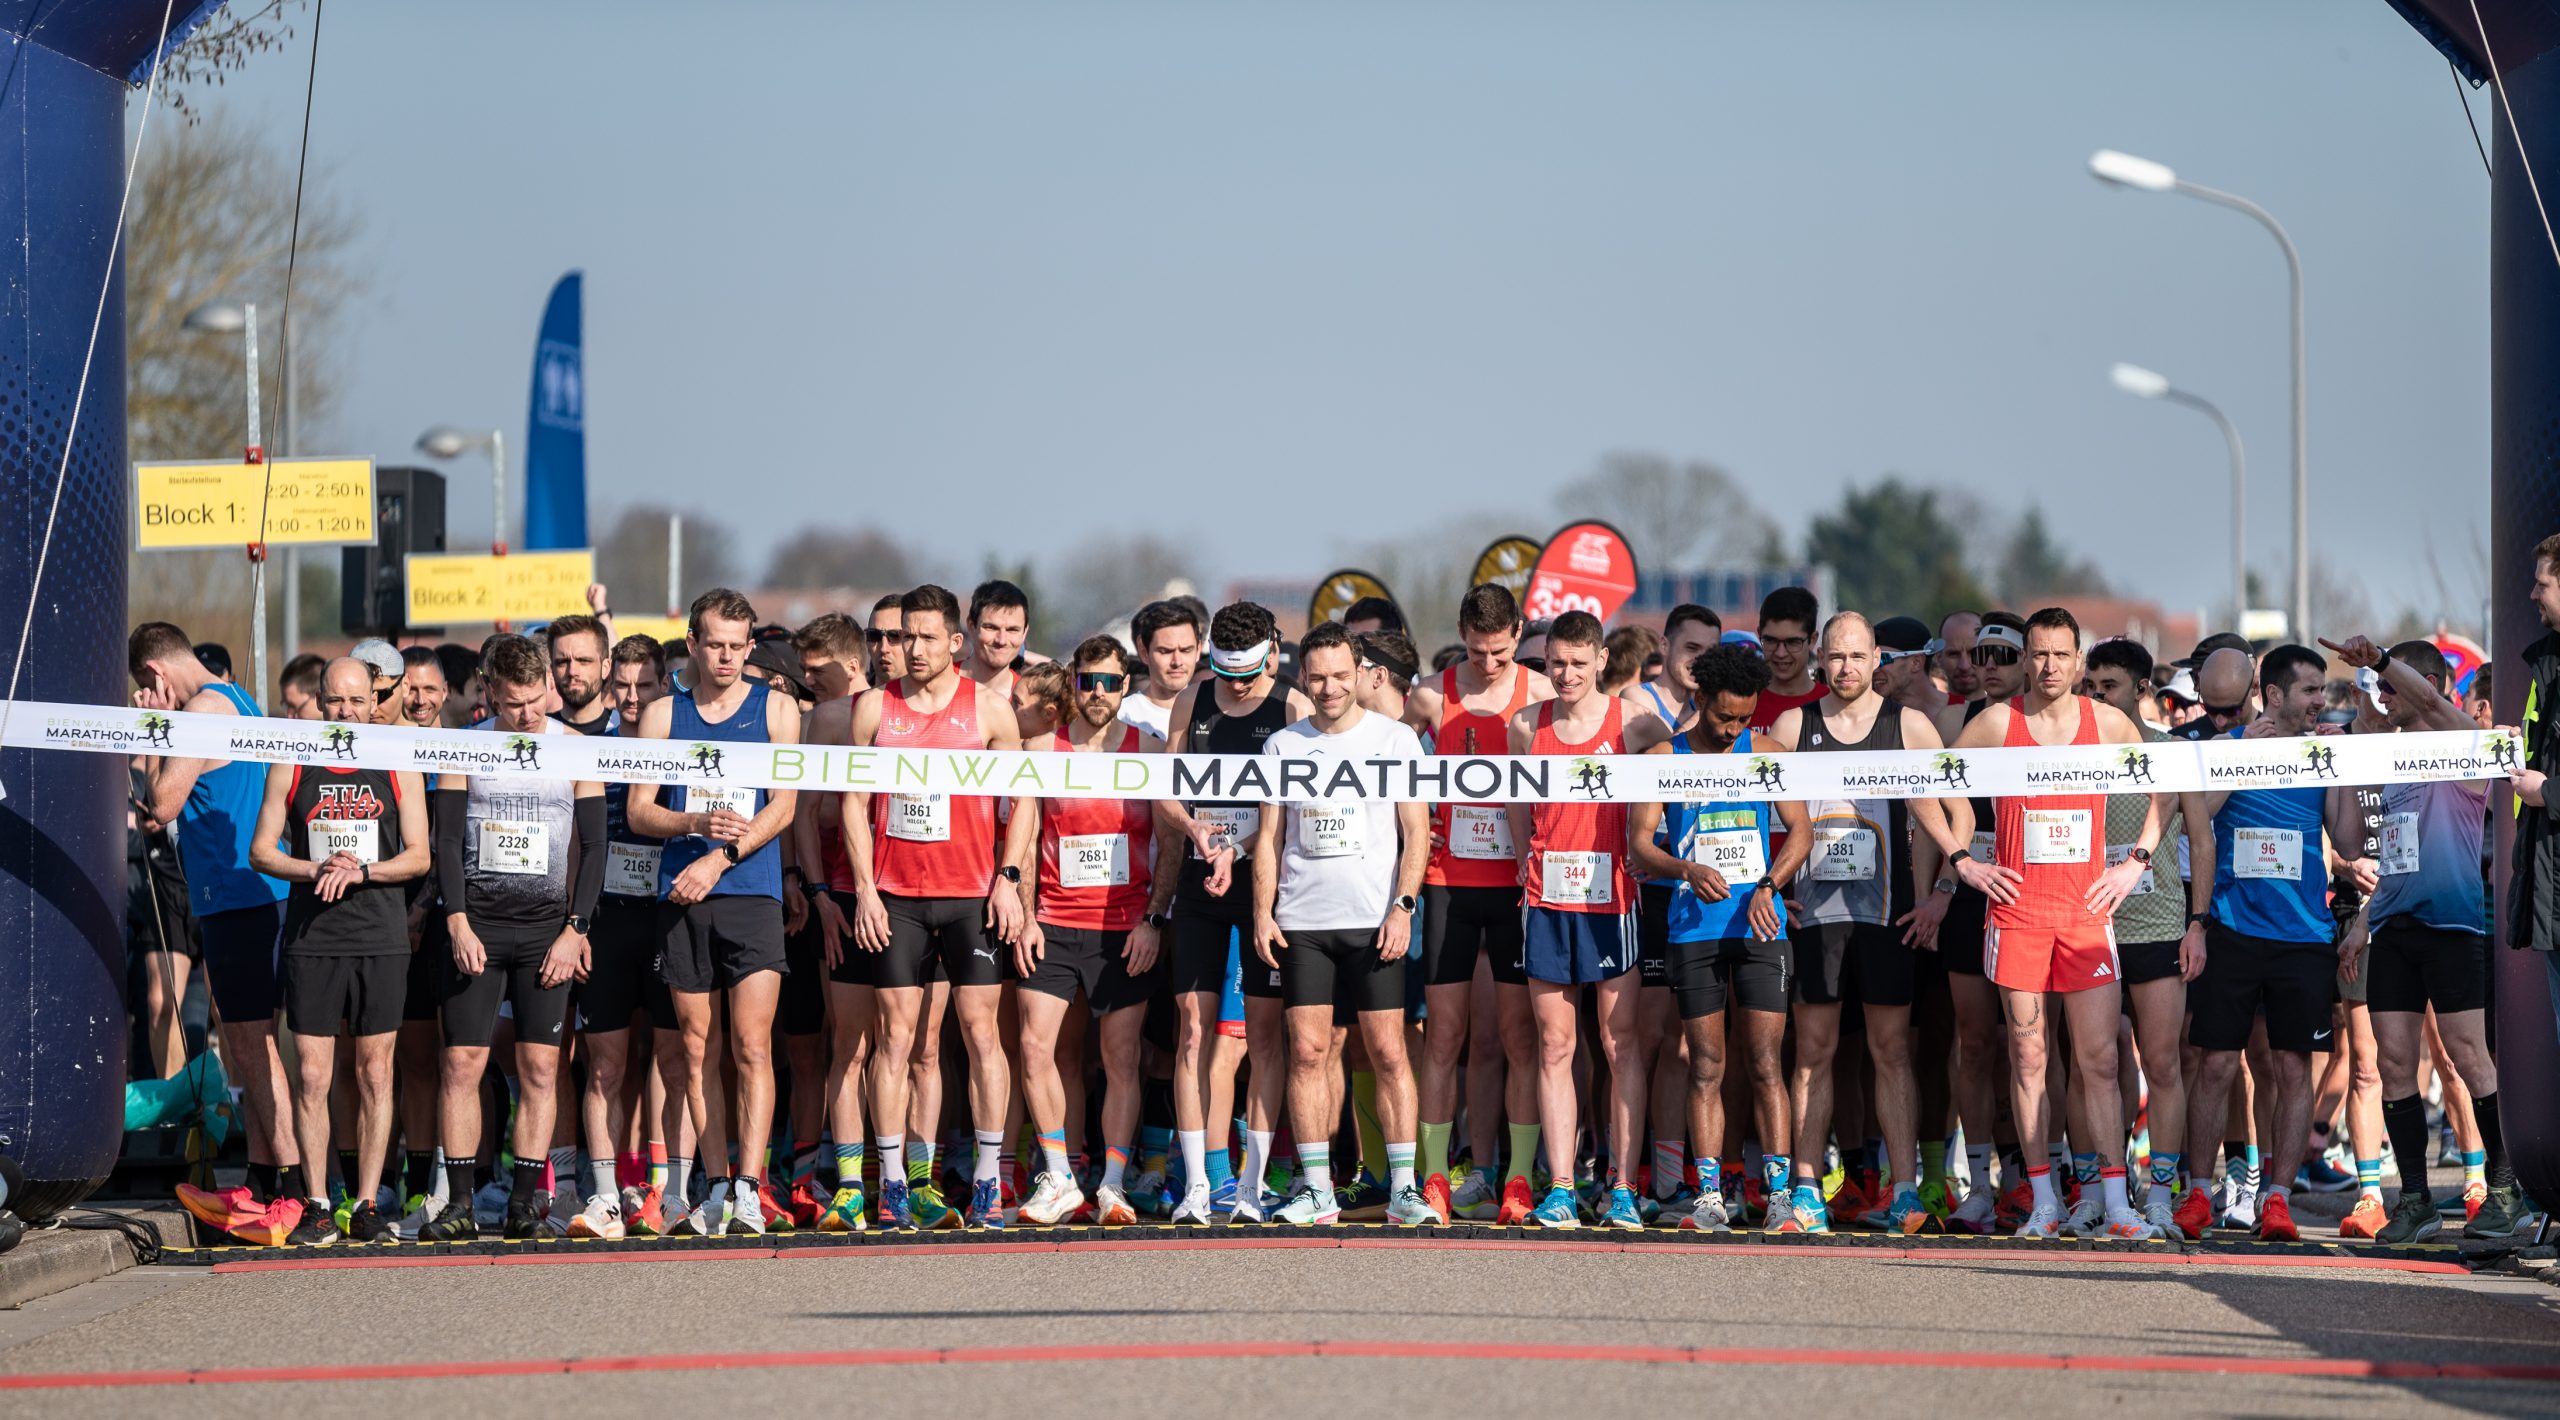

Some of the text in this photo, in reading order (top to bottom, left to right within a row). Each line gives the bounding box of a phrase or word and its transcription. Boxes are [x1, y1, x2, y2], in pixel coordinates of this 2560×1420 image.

[267, 484, 299, 499] 2:20
[315, 483, 350, 498] 2:50
[355, 482, 364, 497] h
[146, 502, 246, 526] Block 1:
[267, 518, 299, 533] 1:00
[318, 517, 351, 532] 1:20
[356, 517, 365, 531] h
[413, 586, 491, 607] Block 2:
[47, 718, 125, 729] BIENWALD
[46, 727, 134, 742] MARATHON
[230, 738, 318, 753] MARATHON
[414, 749, 501, 763] MARATHON
[597, 758, 685, 771] MARATHON
[1843, 765, 1920, 775] BIENWALD
[2210, 764, 2298, 778] MARATHON
[2394, 758, 2482, 771] MARATHON
[771, 748, 1550, 799] BIENWALD MARATHON
[1658, 768, 1736, 777] BIENWALD
[2027, 770, 2115, 782] MARATHON
[1658, 778, 1746, 789] MARATHON
[1843, 774, 1931, 786] MARATHON
[705, 800, 733, 813] 1896
[903, 803, 931, 817] 1861
[1315, 818, 1345, 832] 2720
[1472, 822, 1495, 835] 474
[2048, 825, 2071, 839] 193
[2386, 827, 2399, 842] 147
[328, 835, 358, 847] 1009
[498, 836, 529, 849] 2328
[1715, 846, 1746, 861] 2082
[1826, 843, 1855, 856] 1381
[2261, 842, 2276, 855] 96
[1079, 850, 1108, 863] 2681
[623, 858, 652, 873] 2165
[1564, 866, 1587, 879] 344
